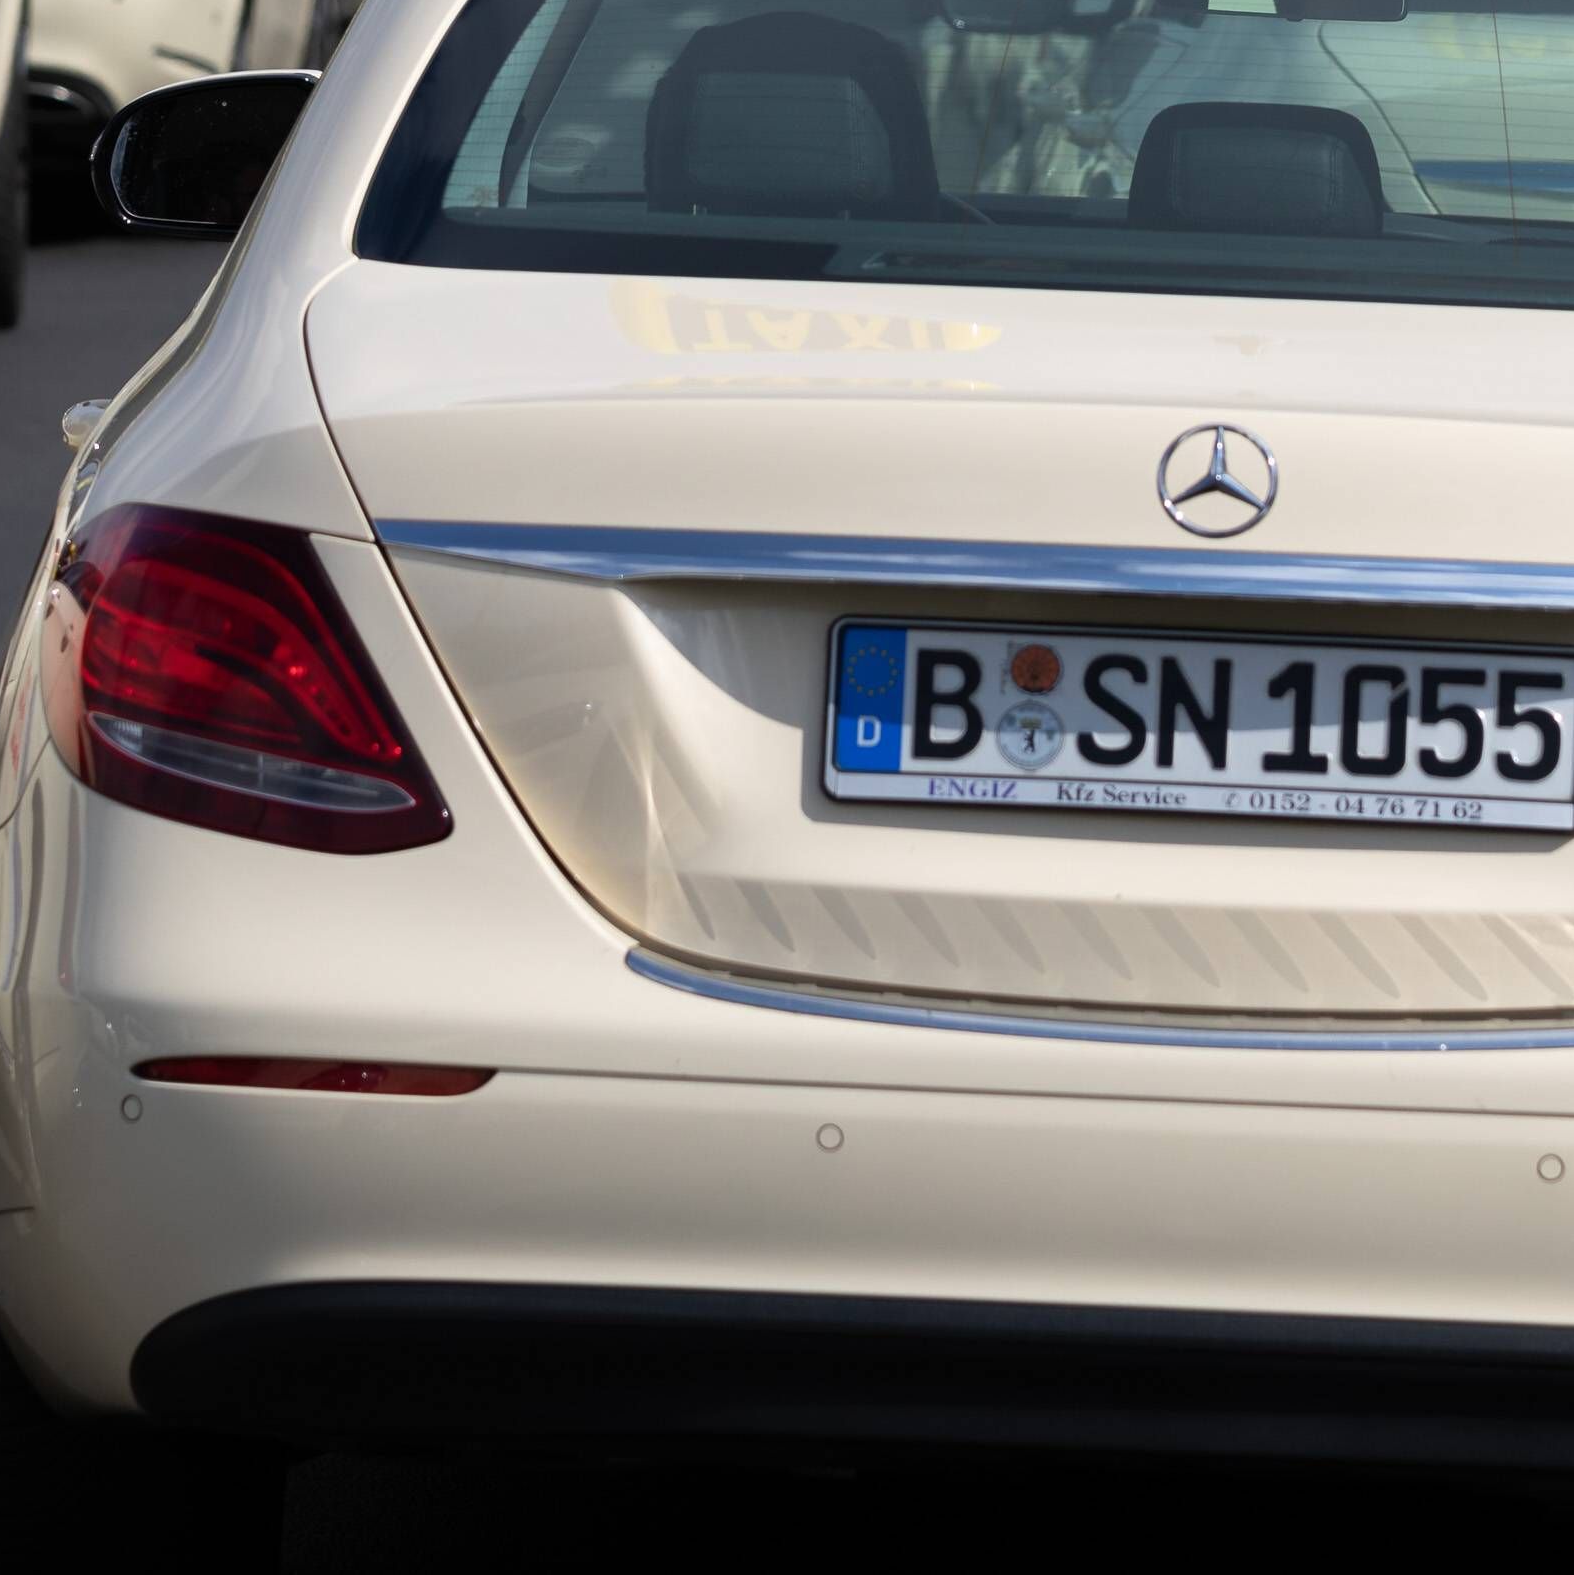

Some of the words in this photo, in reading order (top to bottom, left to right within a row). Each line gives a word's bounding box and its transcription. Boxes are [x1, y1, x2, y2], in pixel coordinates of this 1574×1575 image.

[855, 715, 881, 748] D
[912, 648, 984, 760] B
[1076, 654, 1233, 769] SN
[1262, 661, 1566, 783] 1055
[927, 777, 1018, 800] ENGIZ
[1057, 782, 1094, 803] Kfz
[1103, 784, 1187, 806] Service
[1249, 791, 1311, 812] 0152
[1335, 795, 1365, 815] 04
[1376, 796, 1406, 816] 76
[1413, 799, 1442, 818] 71
[1452, 800, 1484, 820] 62
